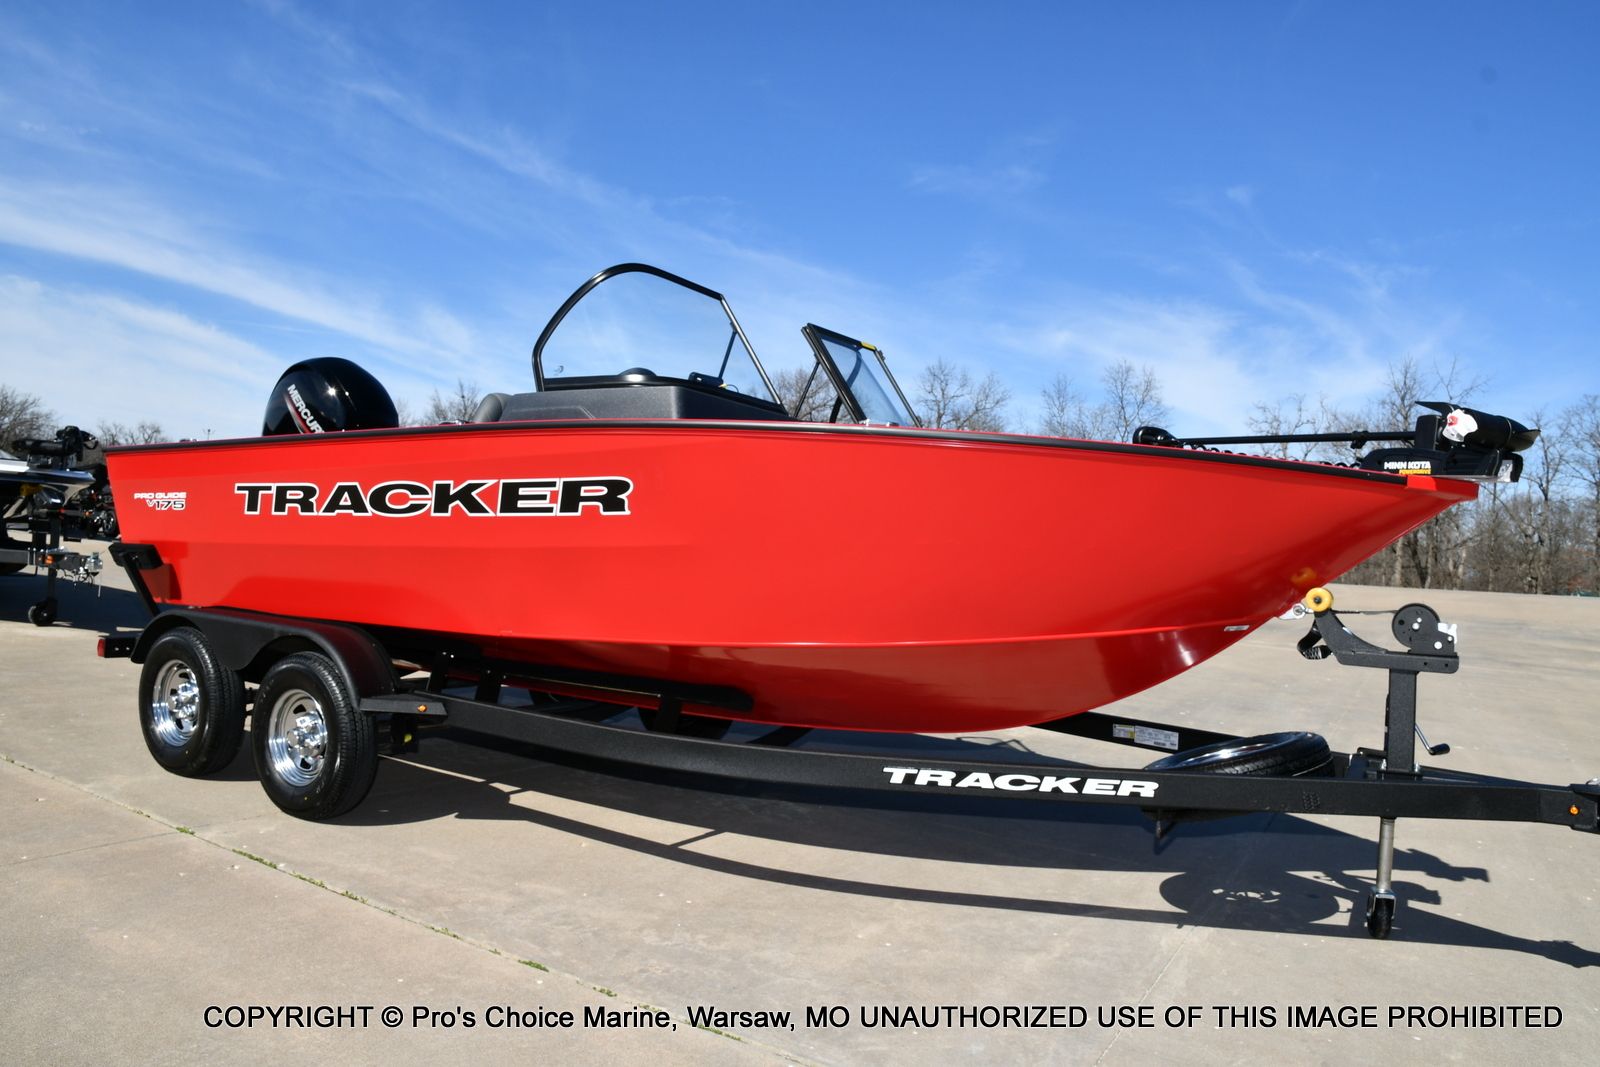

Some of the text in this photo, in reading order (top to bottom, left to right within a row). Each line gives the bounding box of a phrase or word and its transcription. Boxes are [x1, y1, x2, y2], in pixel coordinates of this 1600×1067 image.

[287, 383, 325, 434] MERCUR
[1384, 461, 1431, 469] MINN KOTA
[146, 499, 186, 510] V175
[234, 476, 634, 518] TRACKER
[882, 767, 1159, 798] TRACKER
